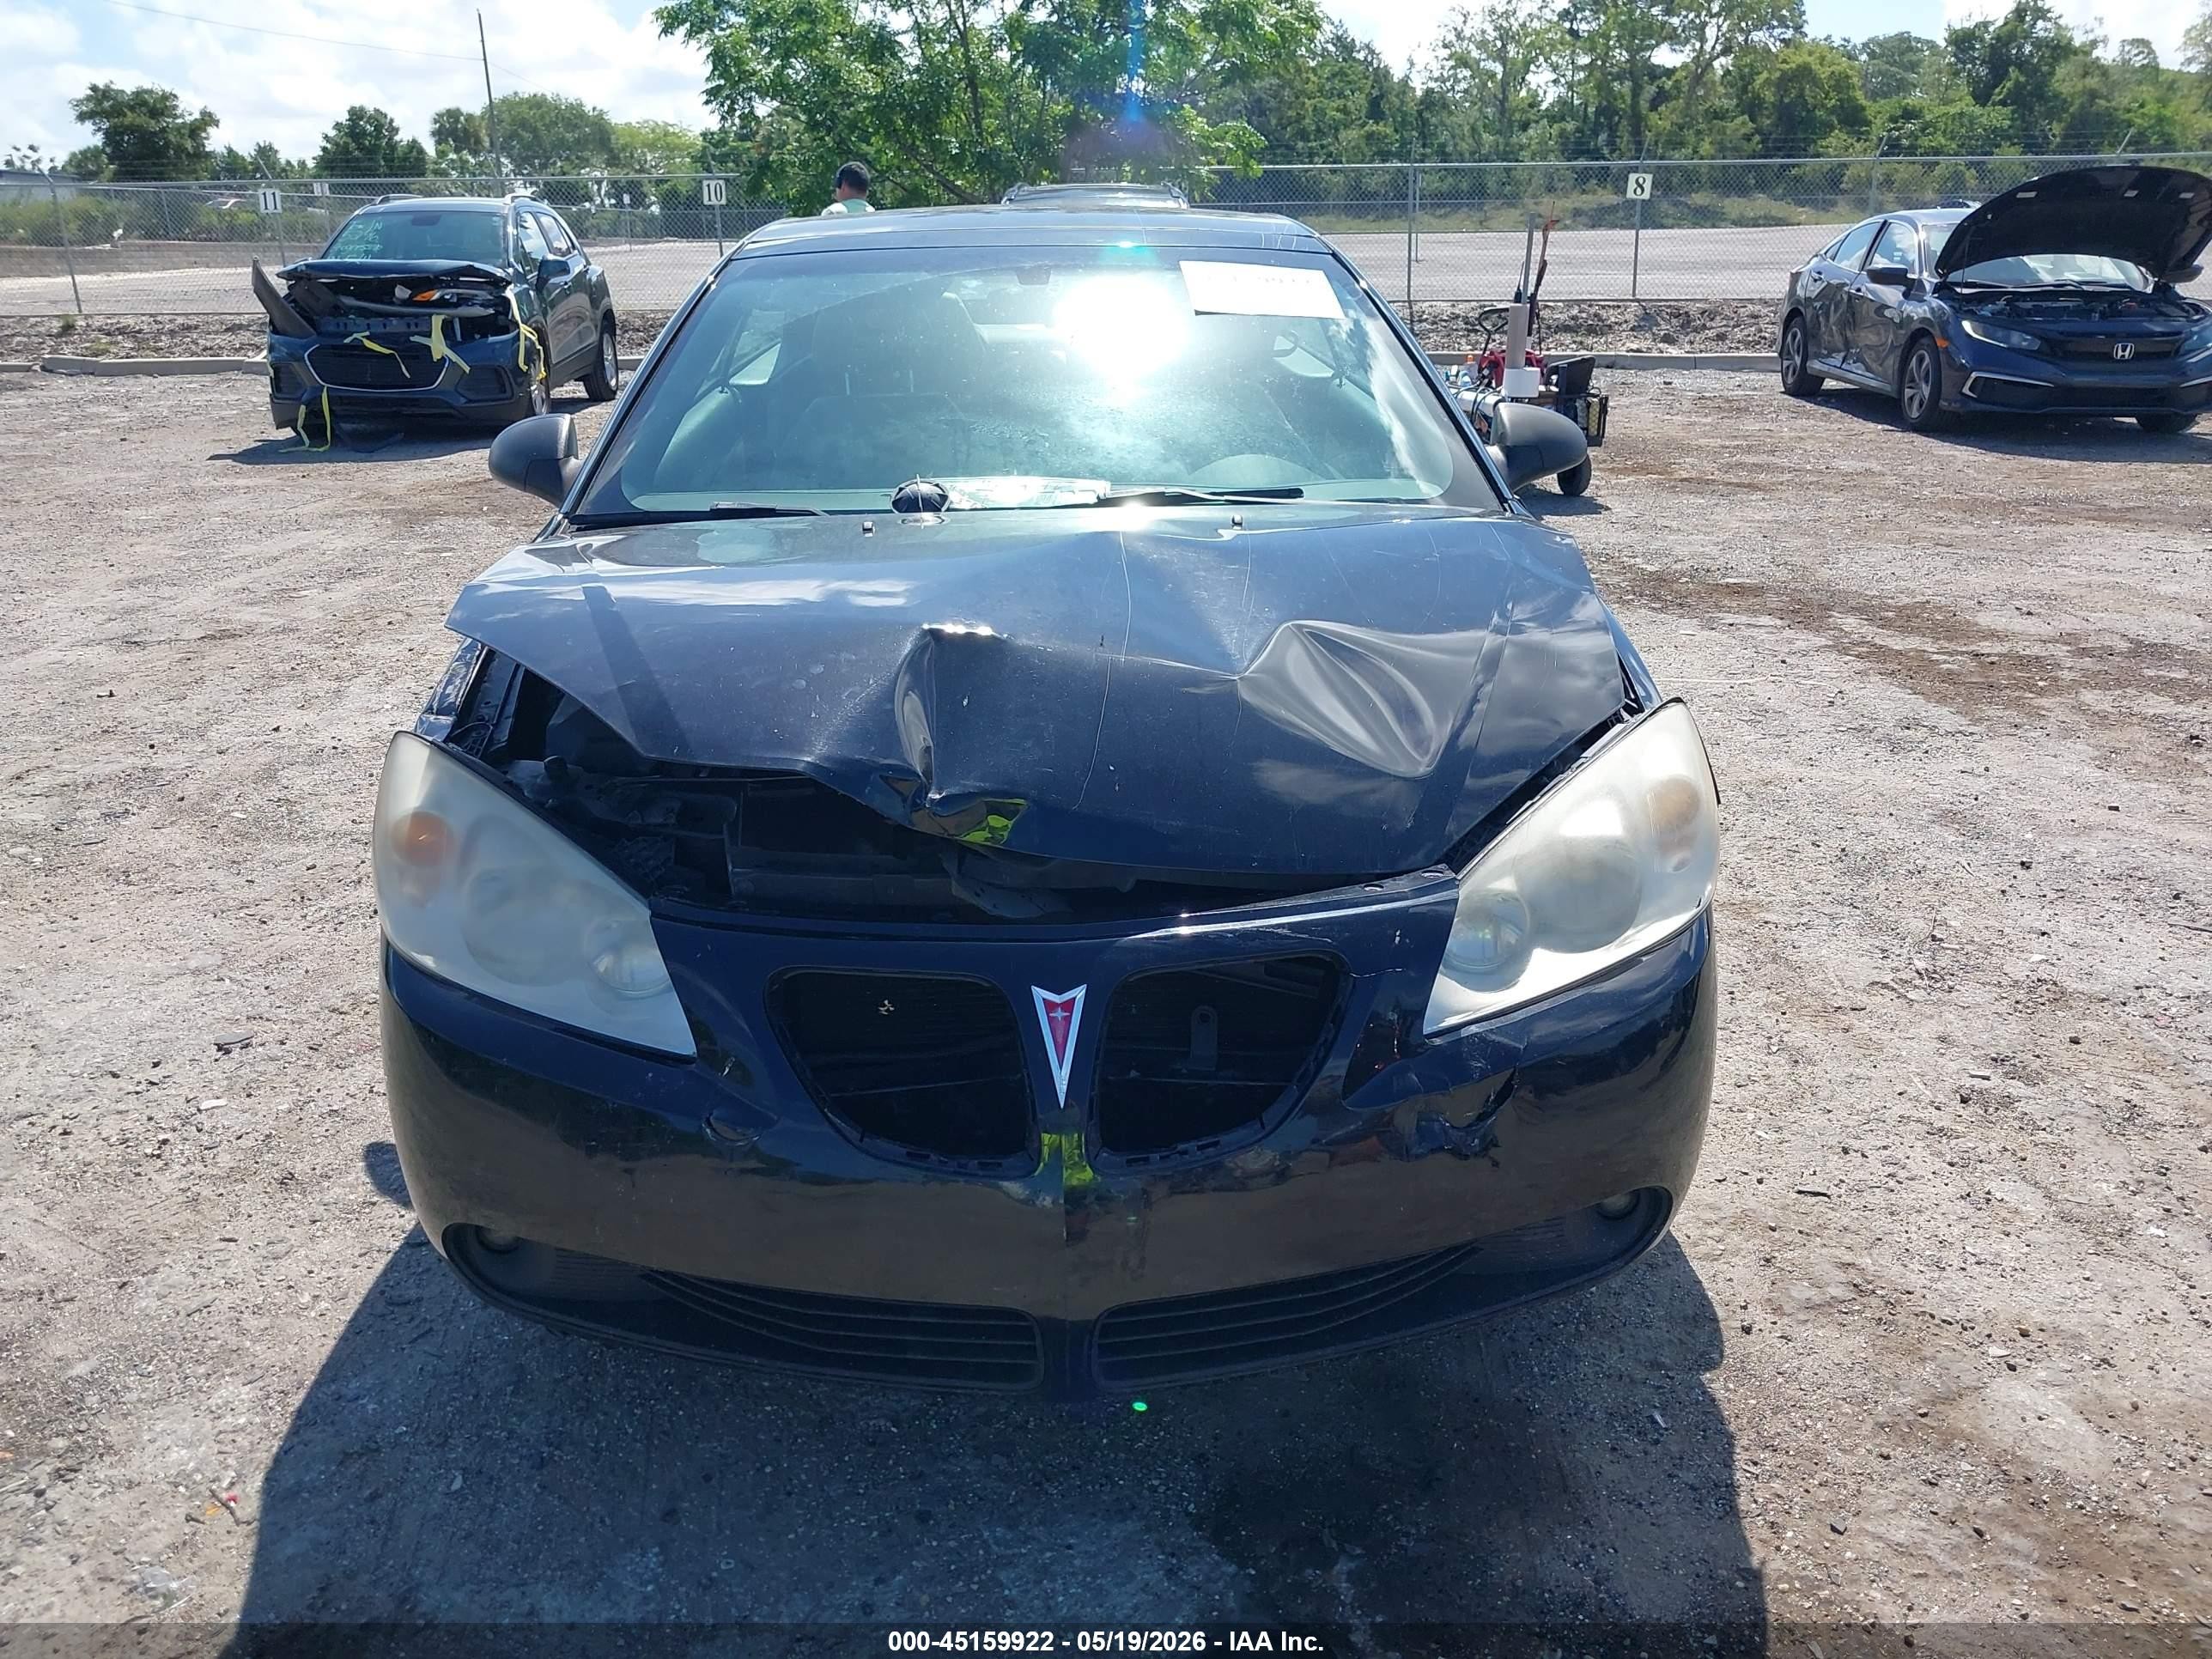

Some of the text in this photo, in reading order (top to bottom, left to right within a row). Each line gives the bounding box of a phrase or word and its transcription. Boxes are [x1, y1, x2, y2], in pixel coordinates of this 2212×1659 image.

[705, 182, 723, 203] 10
[1633, 176, 1646, 196] 8
[261, 191, 278, 211] 11
